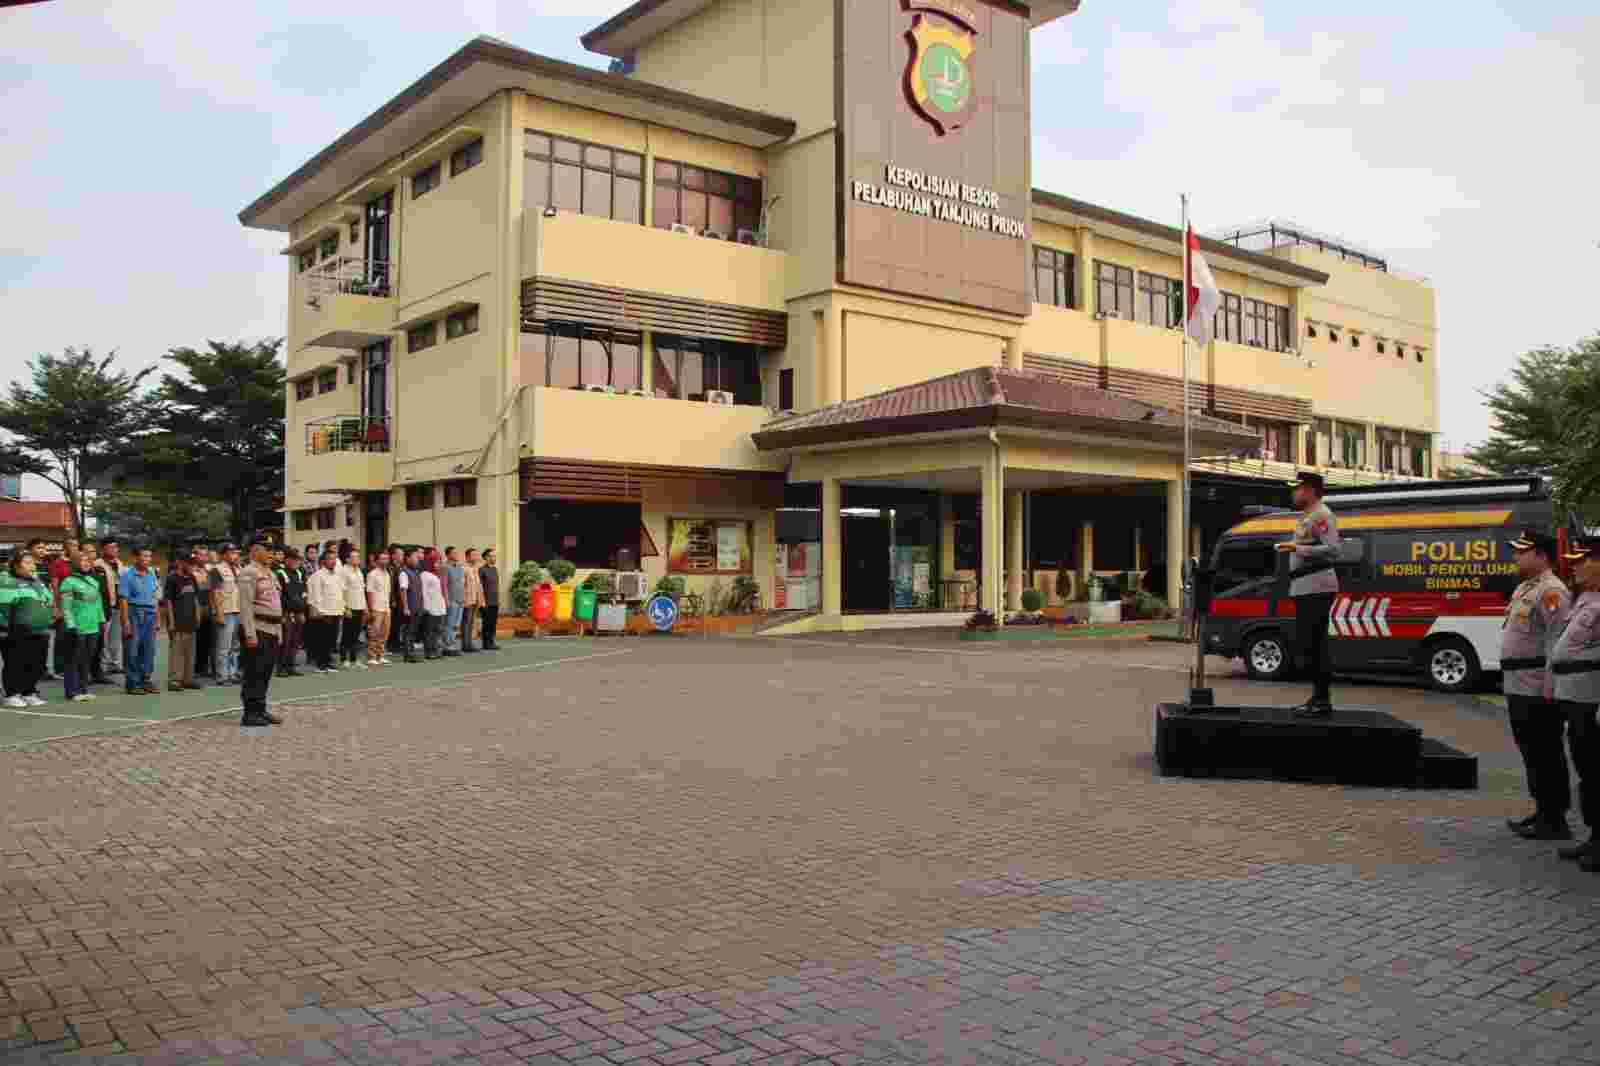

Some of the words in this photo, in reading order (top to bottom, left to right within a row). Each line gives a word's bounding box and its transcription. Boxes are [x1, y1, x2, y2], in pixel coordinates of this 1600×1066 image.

[887, 164, 959, 199] KEPOLISIAN
[961, 184, 999, 209] RESOR
[853, 181, 929, 216] PELABUHAN
[933, 200, 989, 230] TANJUNG
[991, 214, 1024, 238] PRIOK
[1411, 541, 1496, 561] POLISI
[1383, 563, 1425, 576] MOBIL
[1430, 563, 1520, 576] PENYULUHA
[1425, 577, 1481, 590] BINMAS
